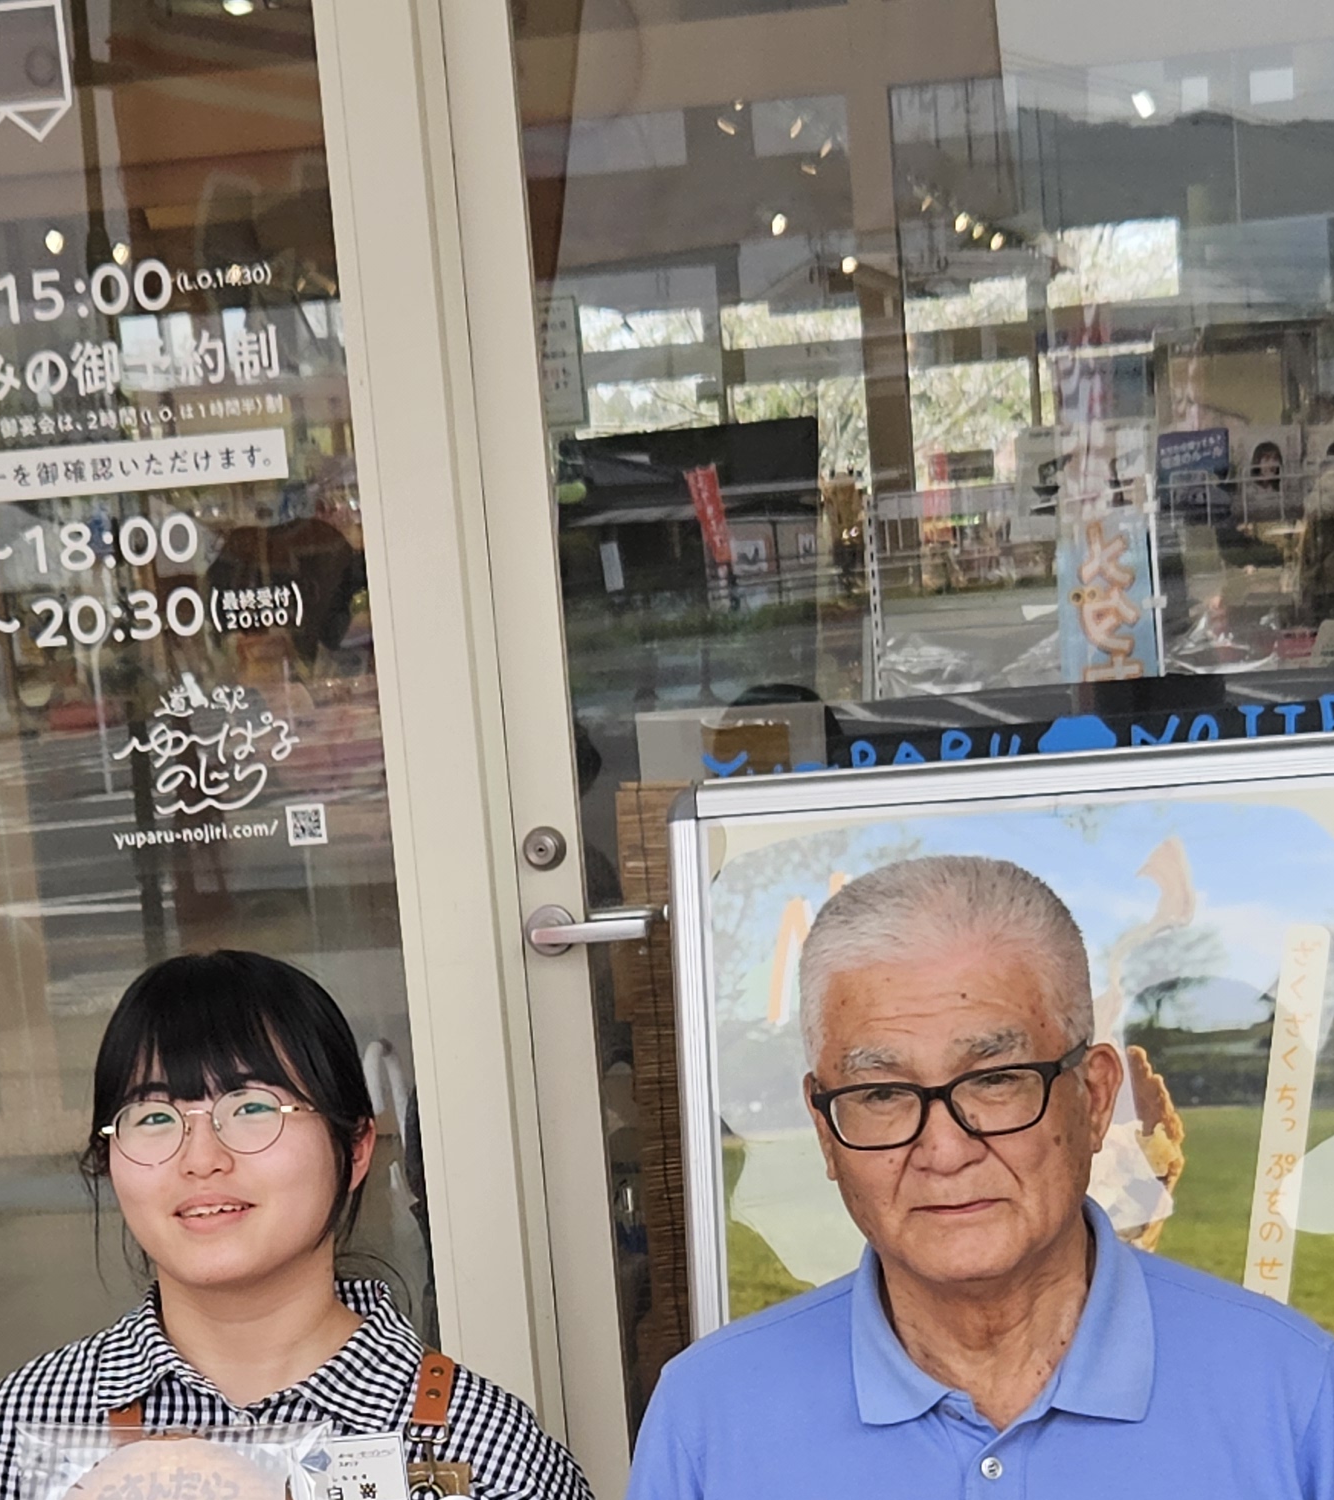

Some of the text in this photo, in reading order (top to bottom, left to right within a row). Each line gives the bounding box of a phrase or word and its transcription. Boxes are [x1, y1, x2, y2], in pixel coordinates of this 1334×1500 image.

[1253, 938, 1323, 1298] ざくざくちっぷをのせ
